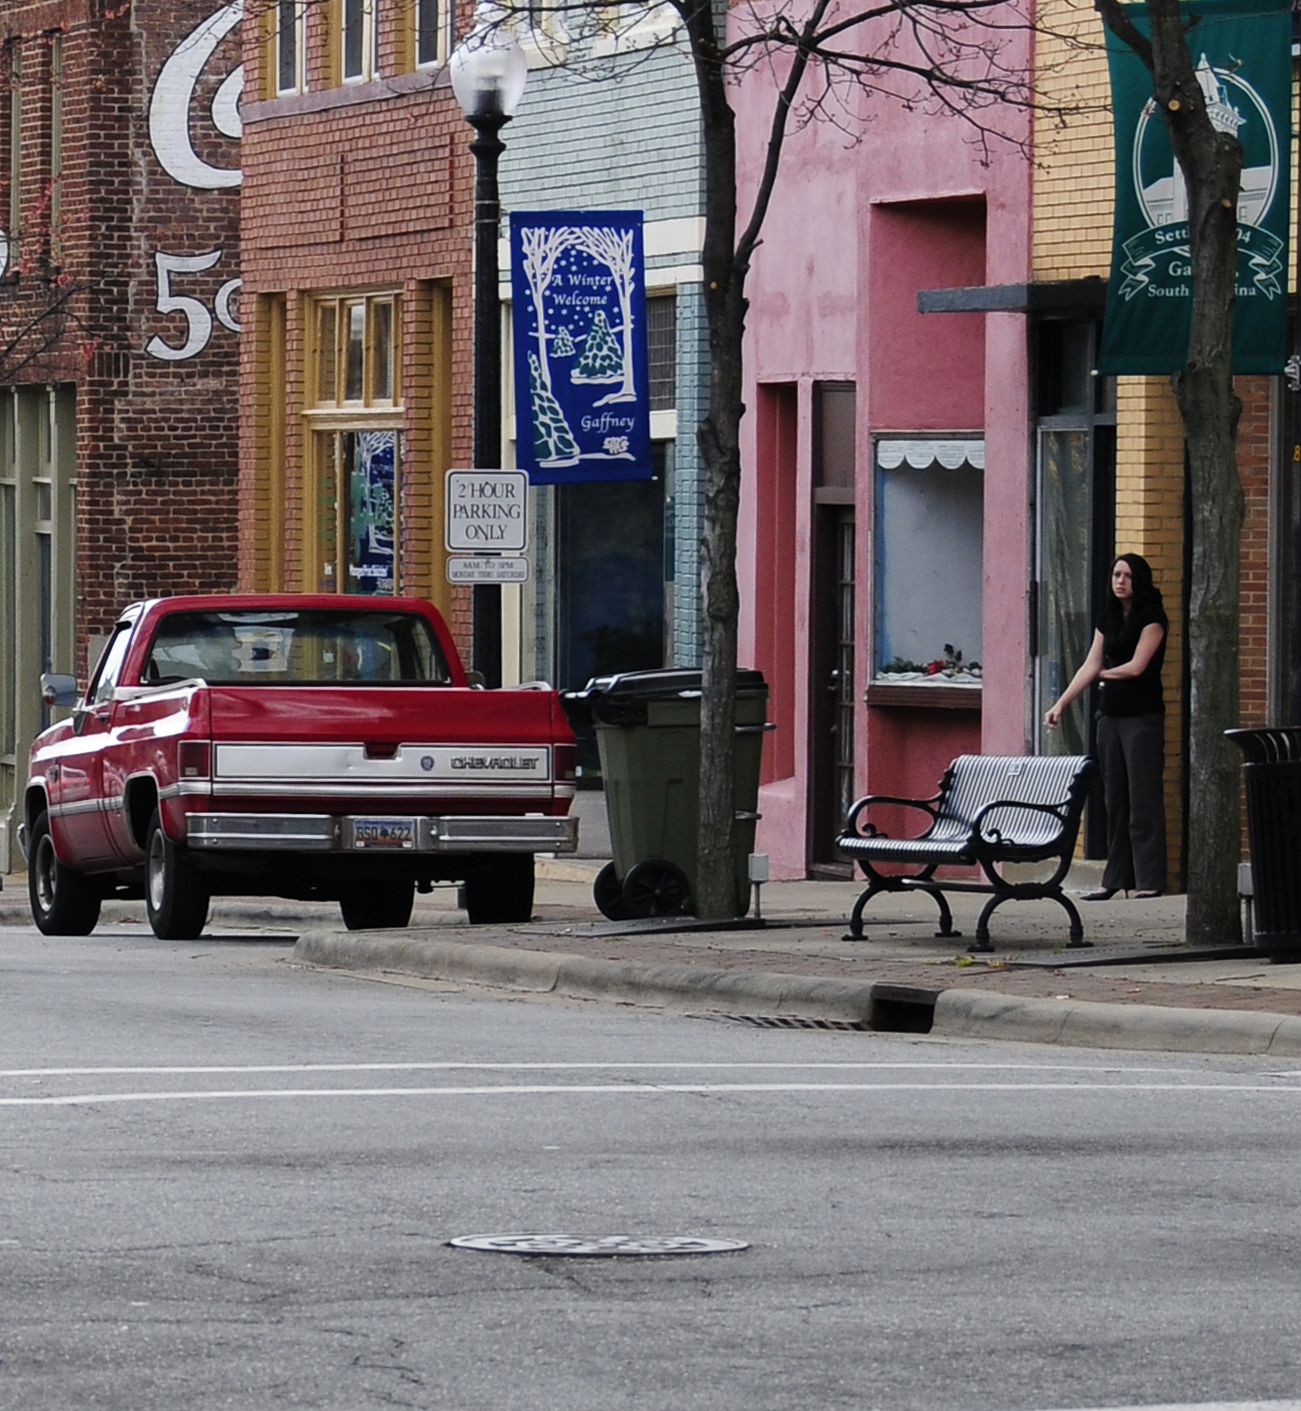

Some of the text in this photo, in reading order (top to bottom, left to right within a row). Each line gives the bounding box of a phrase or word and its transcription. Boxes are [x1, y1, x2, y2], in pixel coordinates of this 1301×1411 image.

[1155, 229, 1190, 244] Sett
[552, 274, 613, 287] A Winter
[552, 290, 608, 306] Welcome
[1147, 284, 1189, 297] South
[580, 411, 636, 434] Gaffney
[458, 481, 516, 499] 2 HOUR
[453, 503, 521, 520] PARKING
[464, 523, 508, 541] ONLY
[450, 755, 539, 771] CHEVROLET
